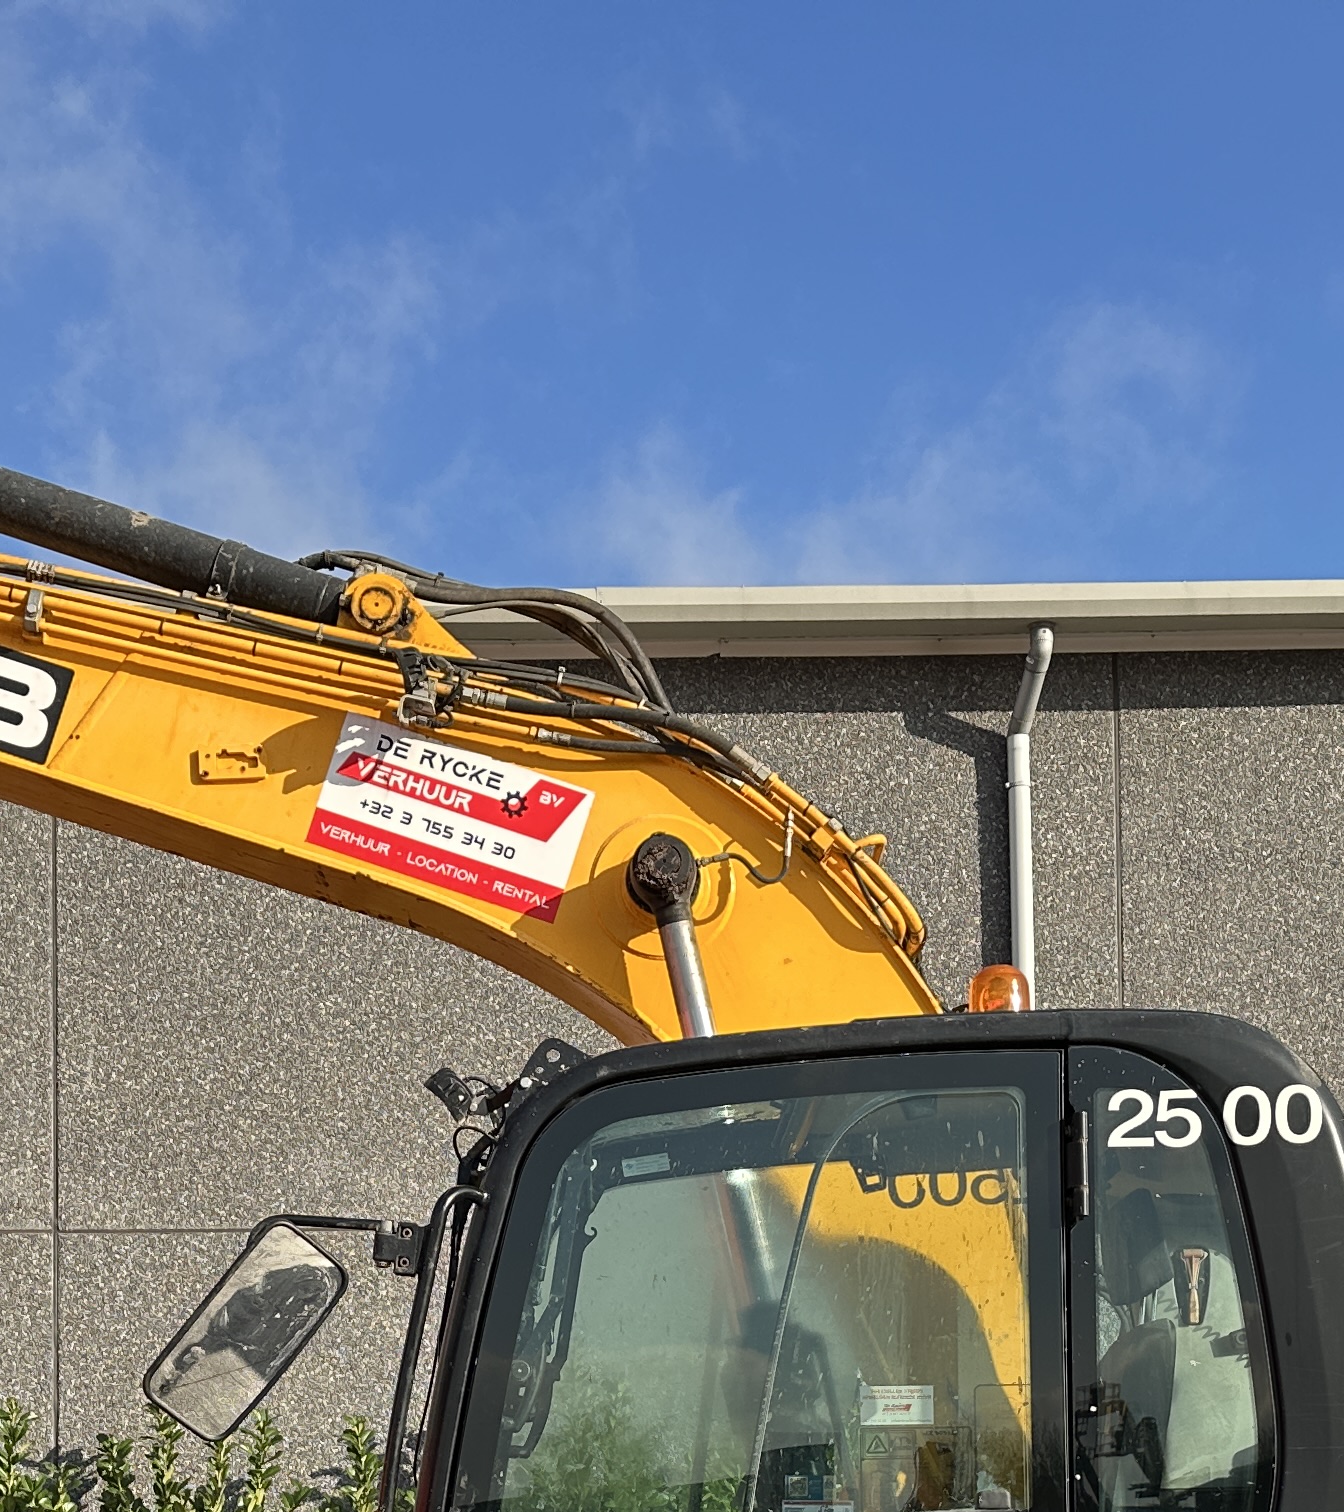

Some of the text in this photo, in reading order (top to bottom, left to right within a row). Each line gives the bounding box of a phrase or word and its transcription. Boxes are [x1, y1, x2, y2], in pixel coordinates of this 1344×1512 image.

[357, 757, 473, 813] VERHUUR
[376, 734, 504, 790] DE RYCKE
[539, 790, 565, 808] BV
[359, 799, 516, 860] +32 3 755 34 30
[319, 821, 392, 856] VERHUUR
[406, 851, 479, 884] LOCATION
[492, 879, 550, 909] RENTAL
